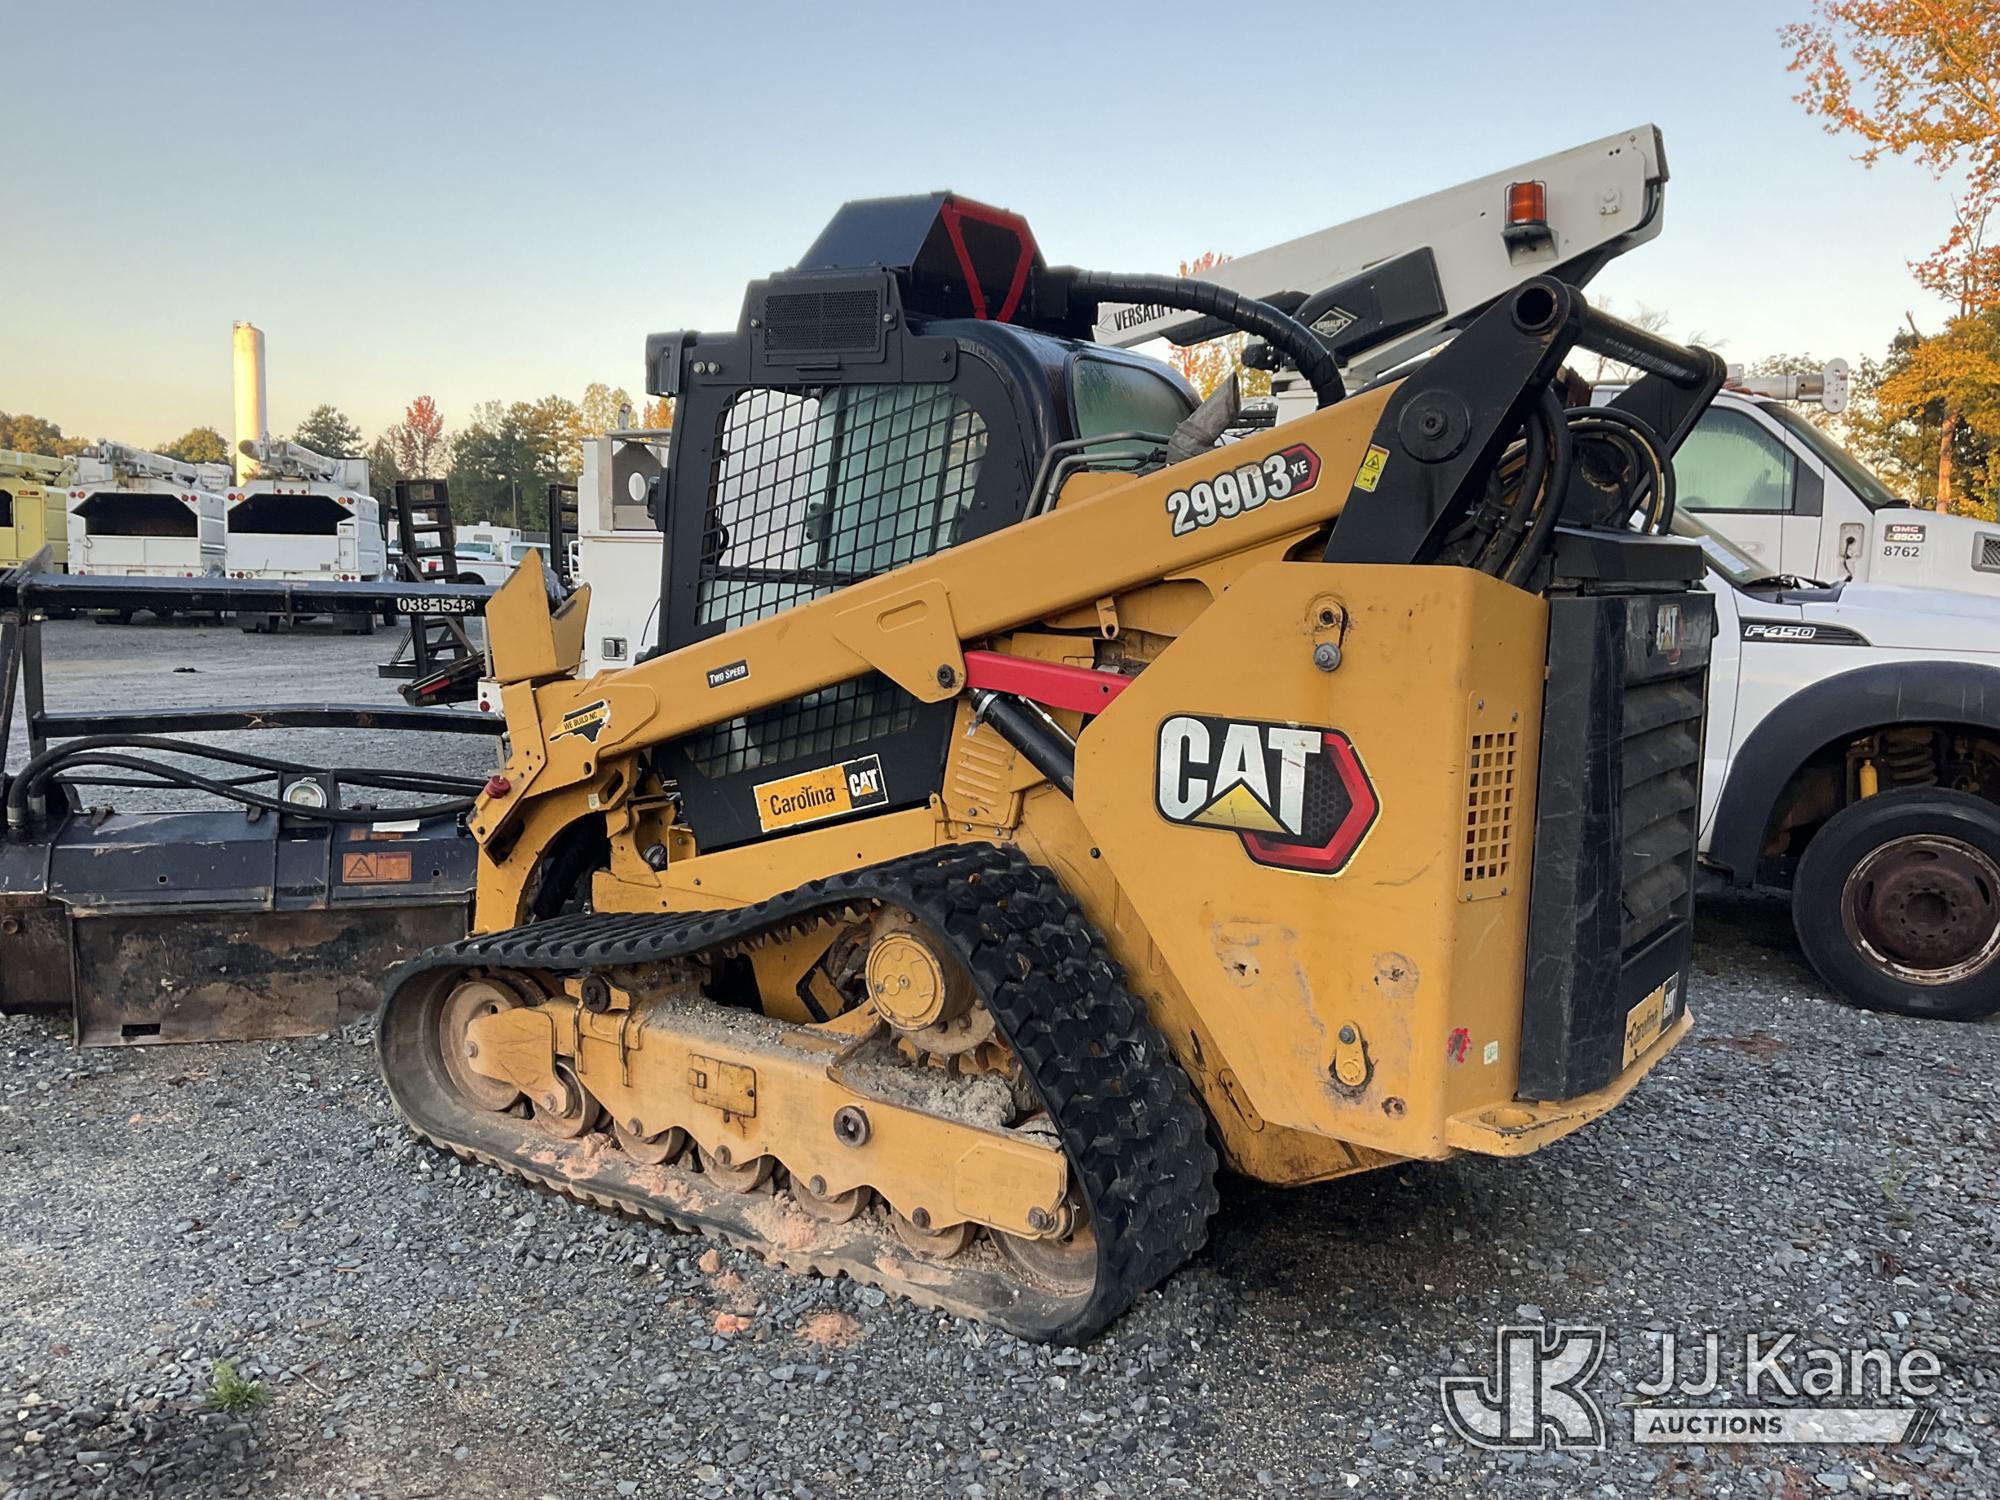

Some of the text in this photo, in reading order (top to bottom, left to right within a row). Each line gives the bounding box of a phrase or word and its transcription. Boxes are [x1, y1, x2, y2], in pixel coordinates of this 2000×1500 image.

[1166, 453, 1309, 537] 299D3 XE
[1892, 525, 1919, 533] GMC
[1883, 545, 1920, 557] 8762
[1656, 605, 1678, 651] CAT
[1744, 624, 1816, 639] F-450
[563, 711, 598, 731] WE BUILD NC
[769, 768, 879, 816] Carolina CAT
[1159, 716, 1322, 836] CAT
